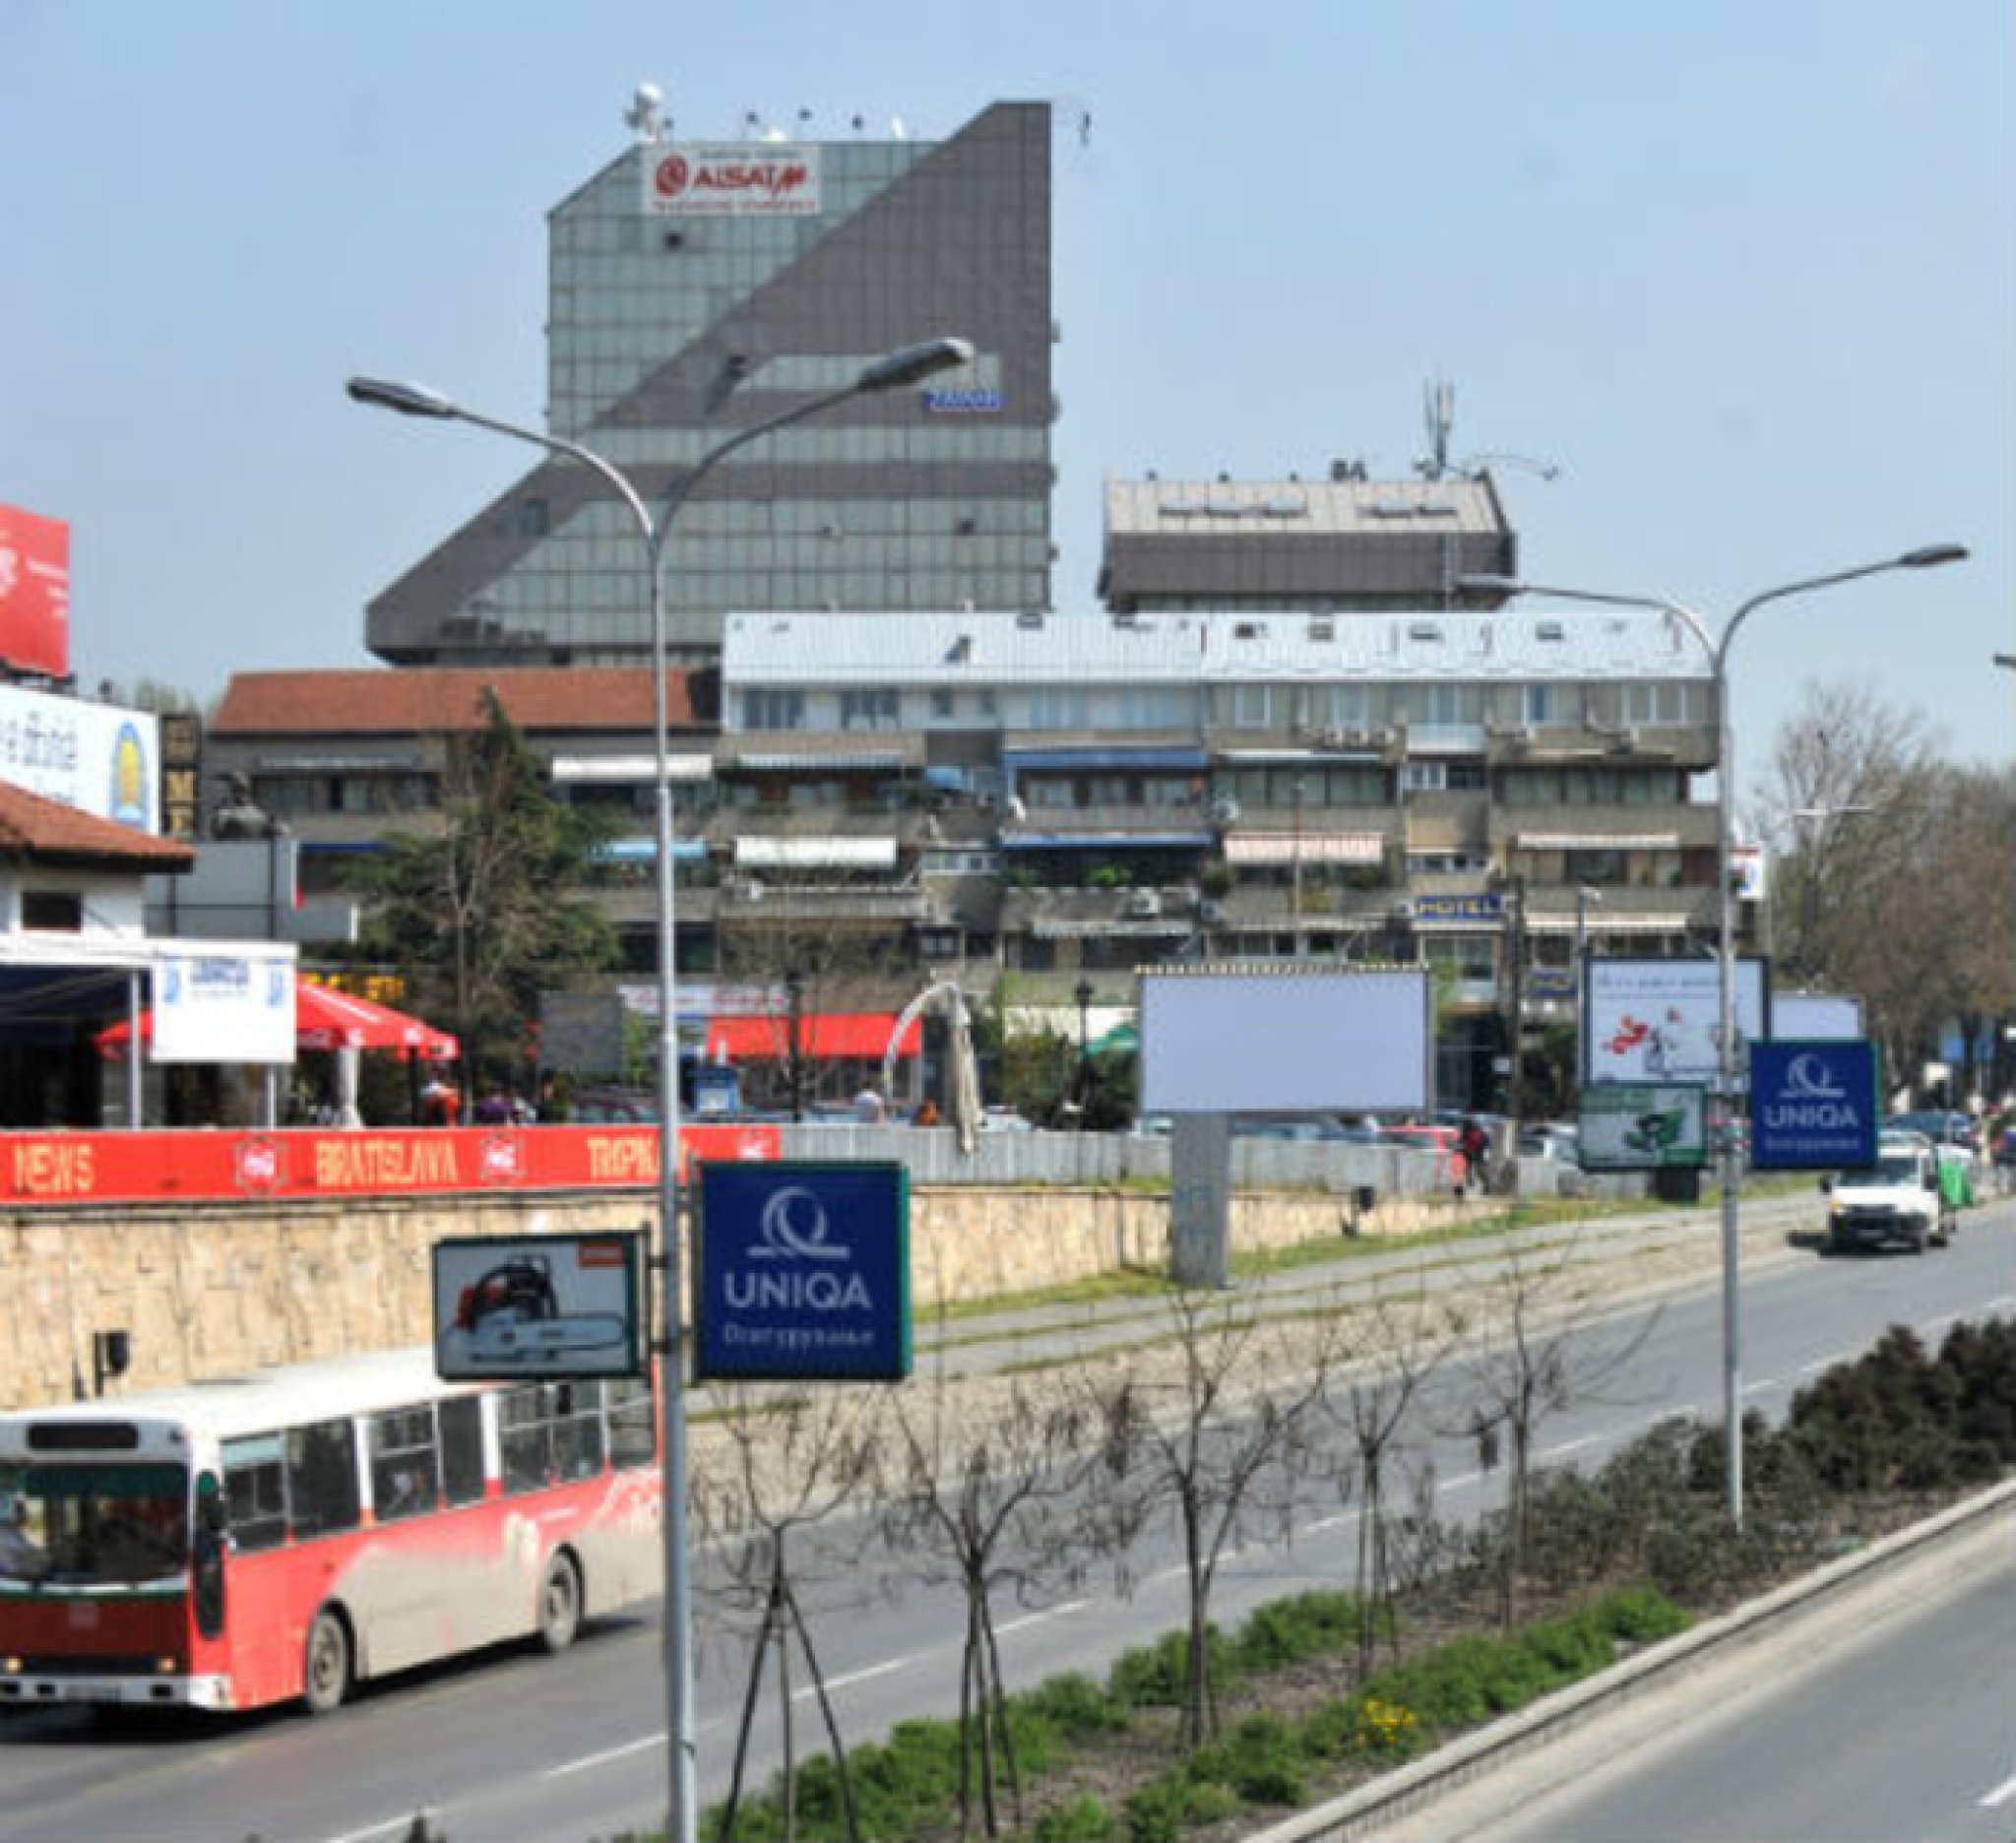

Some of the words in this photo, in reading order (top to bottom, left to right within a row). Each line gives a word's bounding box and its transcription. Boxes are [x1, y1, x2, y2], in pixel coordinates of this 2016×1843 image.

[1763, 1104, 1858, 1129] UNIQA
[14, 1142, 95, 1193] NEWS
[316, 1139, 459, 1187] BRATISLAVA
[724, 1271, 874, 1309] UNIQA
